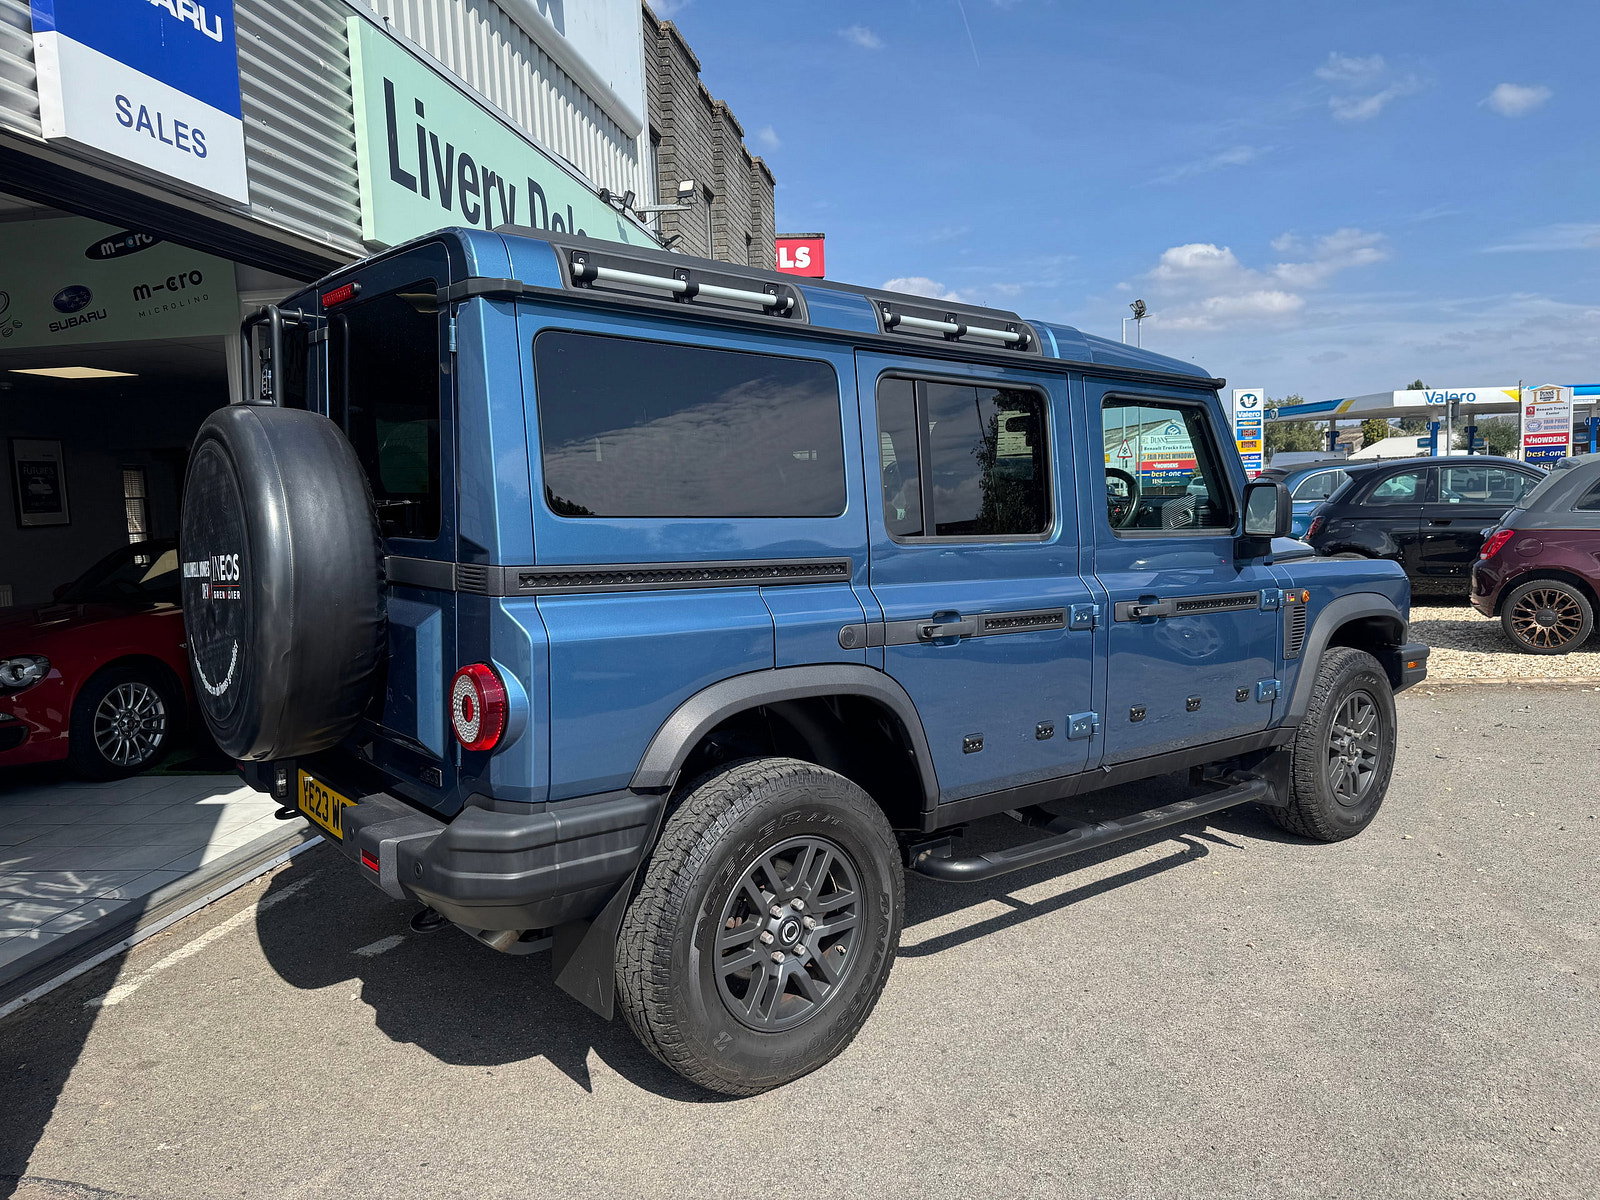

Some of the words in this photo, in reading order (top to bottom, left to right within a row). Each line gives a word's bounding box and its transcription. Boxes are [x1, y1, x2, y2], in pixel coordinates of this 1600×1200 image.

[115, 94, 208, 159] SALES
[383, 76, 516, 231] Livery
[775, 246, 811, 268] LS
[138, 294, 210, 319] MICROLINO
[49, 308, 108, 333] SUBARU
[1424, 391, 1476, 403] Valero
[1532, 435, 1567, 443] HOWDENS
[211, 553, 240, 581] INEOS
[303, 776, 328, 823] YE23
